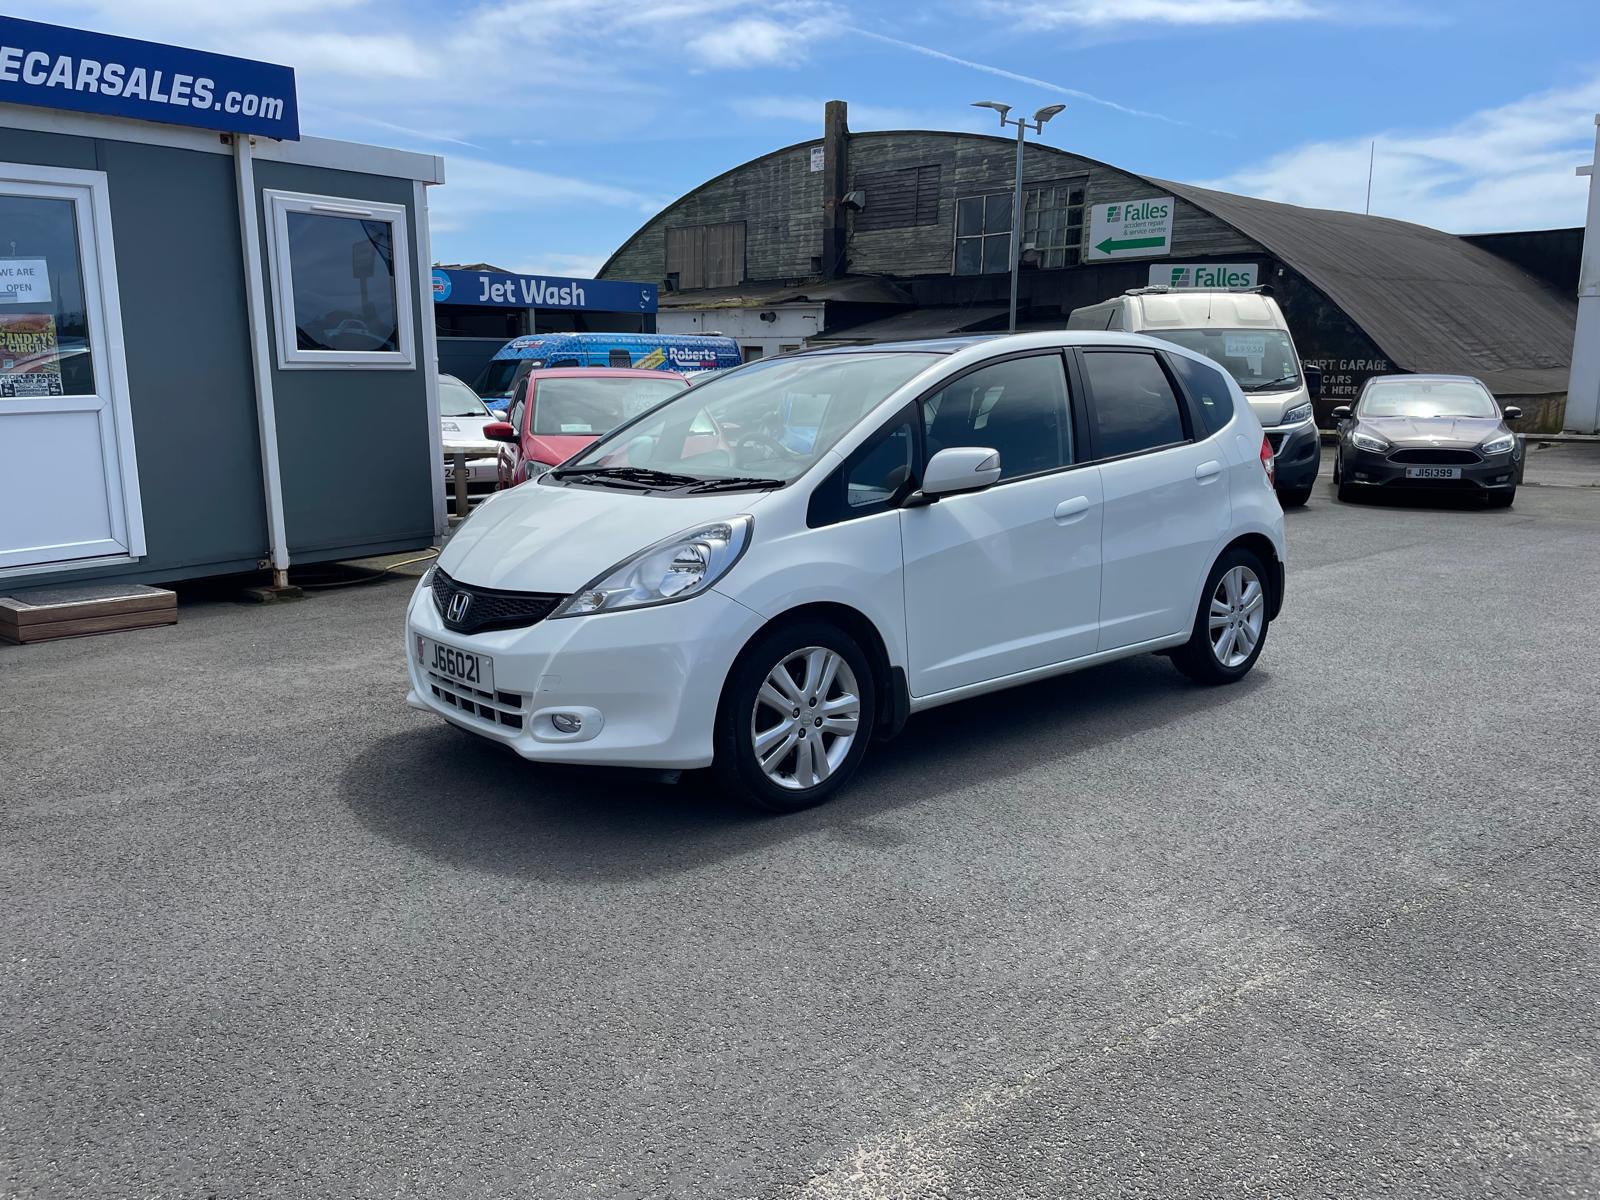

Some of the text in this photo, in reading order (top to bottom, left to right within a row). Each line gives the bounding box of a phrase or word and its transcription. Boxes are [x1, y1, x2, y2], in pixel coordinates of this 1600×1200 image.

[1124, 202, 1168, 221] Falles
[1147, 219, 1165, 227] repair
[1148, 226, 1167, 234] centre
[0, 268, 35, 276] WE ARE
[1194, 267, 1250, 287] Falles
[6, 283, 32, 292] OPEN
[479, 276, 585, 306] Jet Wash
[0, 332, 54, 347] GANDEYS
[8, 343, 48, 353] CIRCUS
[669, 347, 716, 361] Roberts
[1339, 359, 1387, 371] GARAGE
[1322, 375, 1352, 384] CARS
[1331, 386, 1358, 395] HERE
[431, 644, 480, 684] J66021
